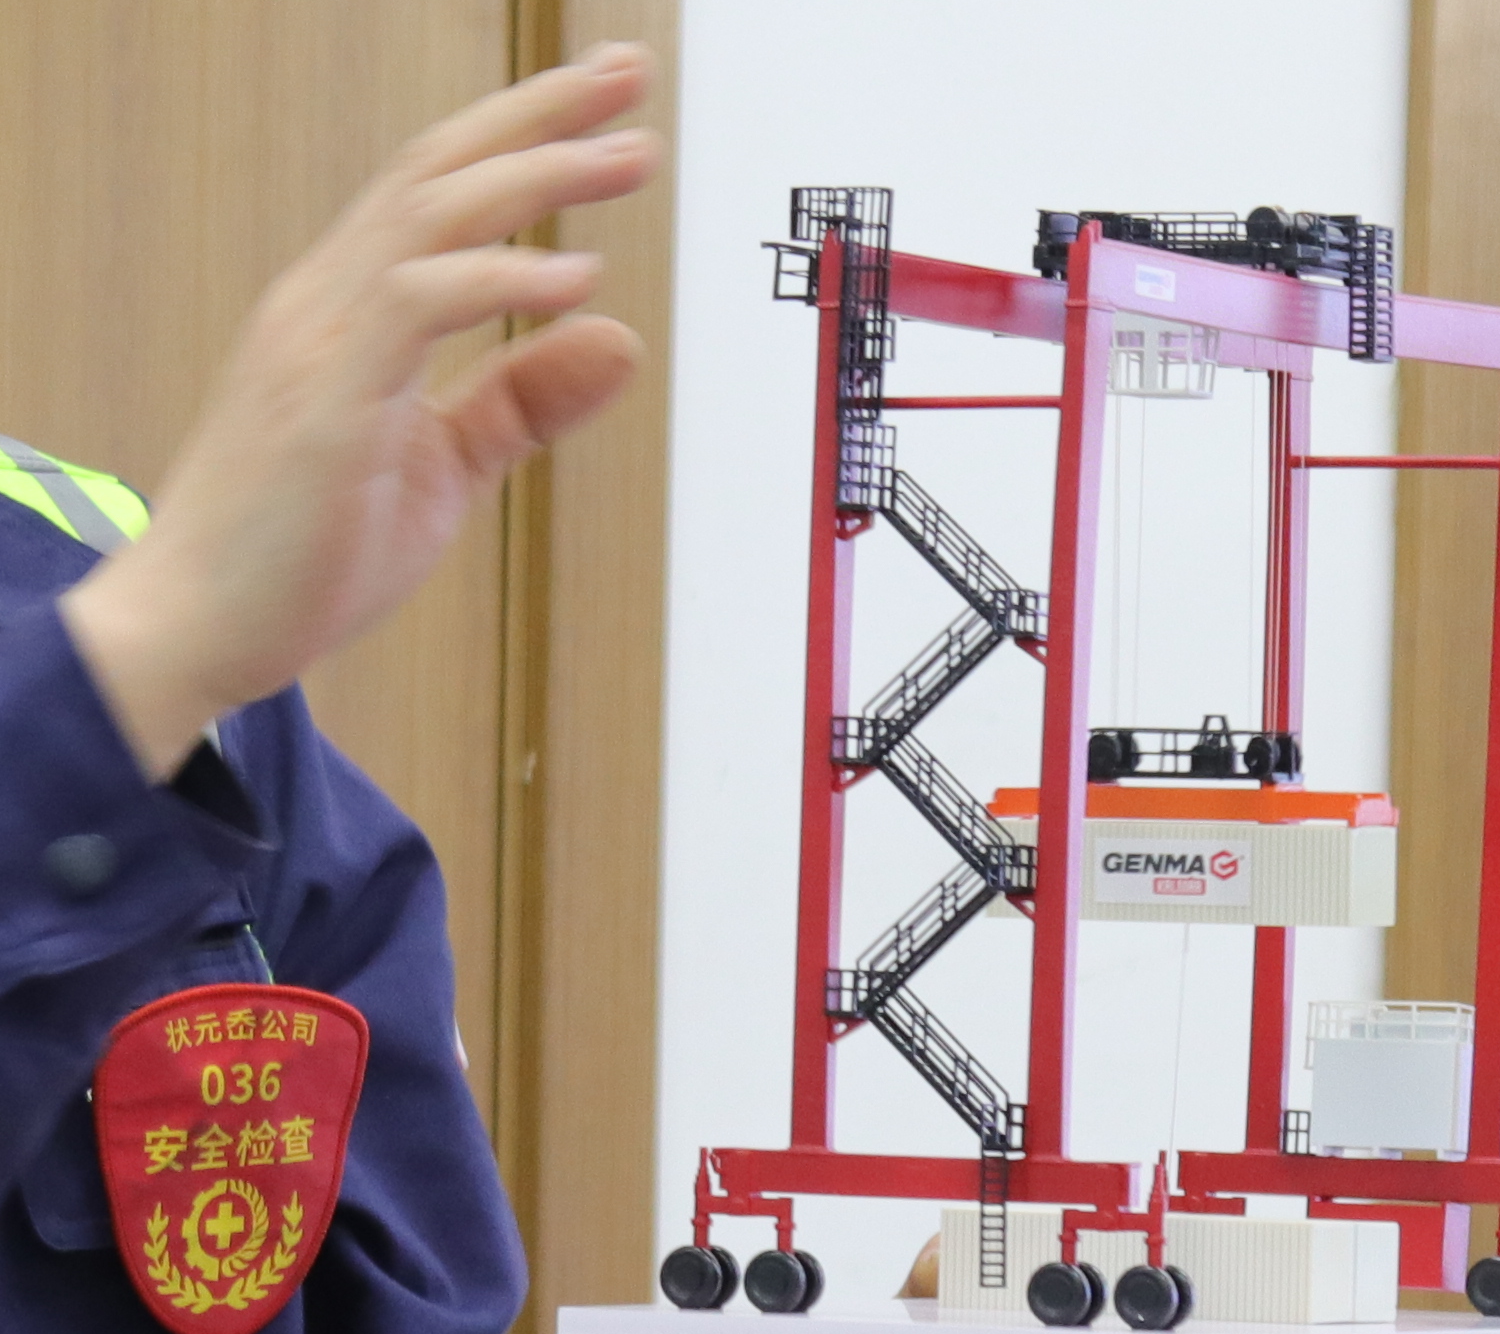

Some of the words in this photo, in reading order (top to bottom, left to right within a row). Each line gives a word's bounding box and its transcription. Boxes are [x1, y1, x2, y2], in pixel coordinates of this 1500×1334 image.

[1102, 852, 1206, 875] GENMA
[166, 1008, 318, 1052] 状元岙公司
[201, 1062, 281, 1104] 036
[144, 1114, 315, 1175] 安全检查
